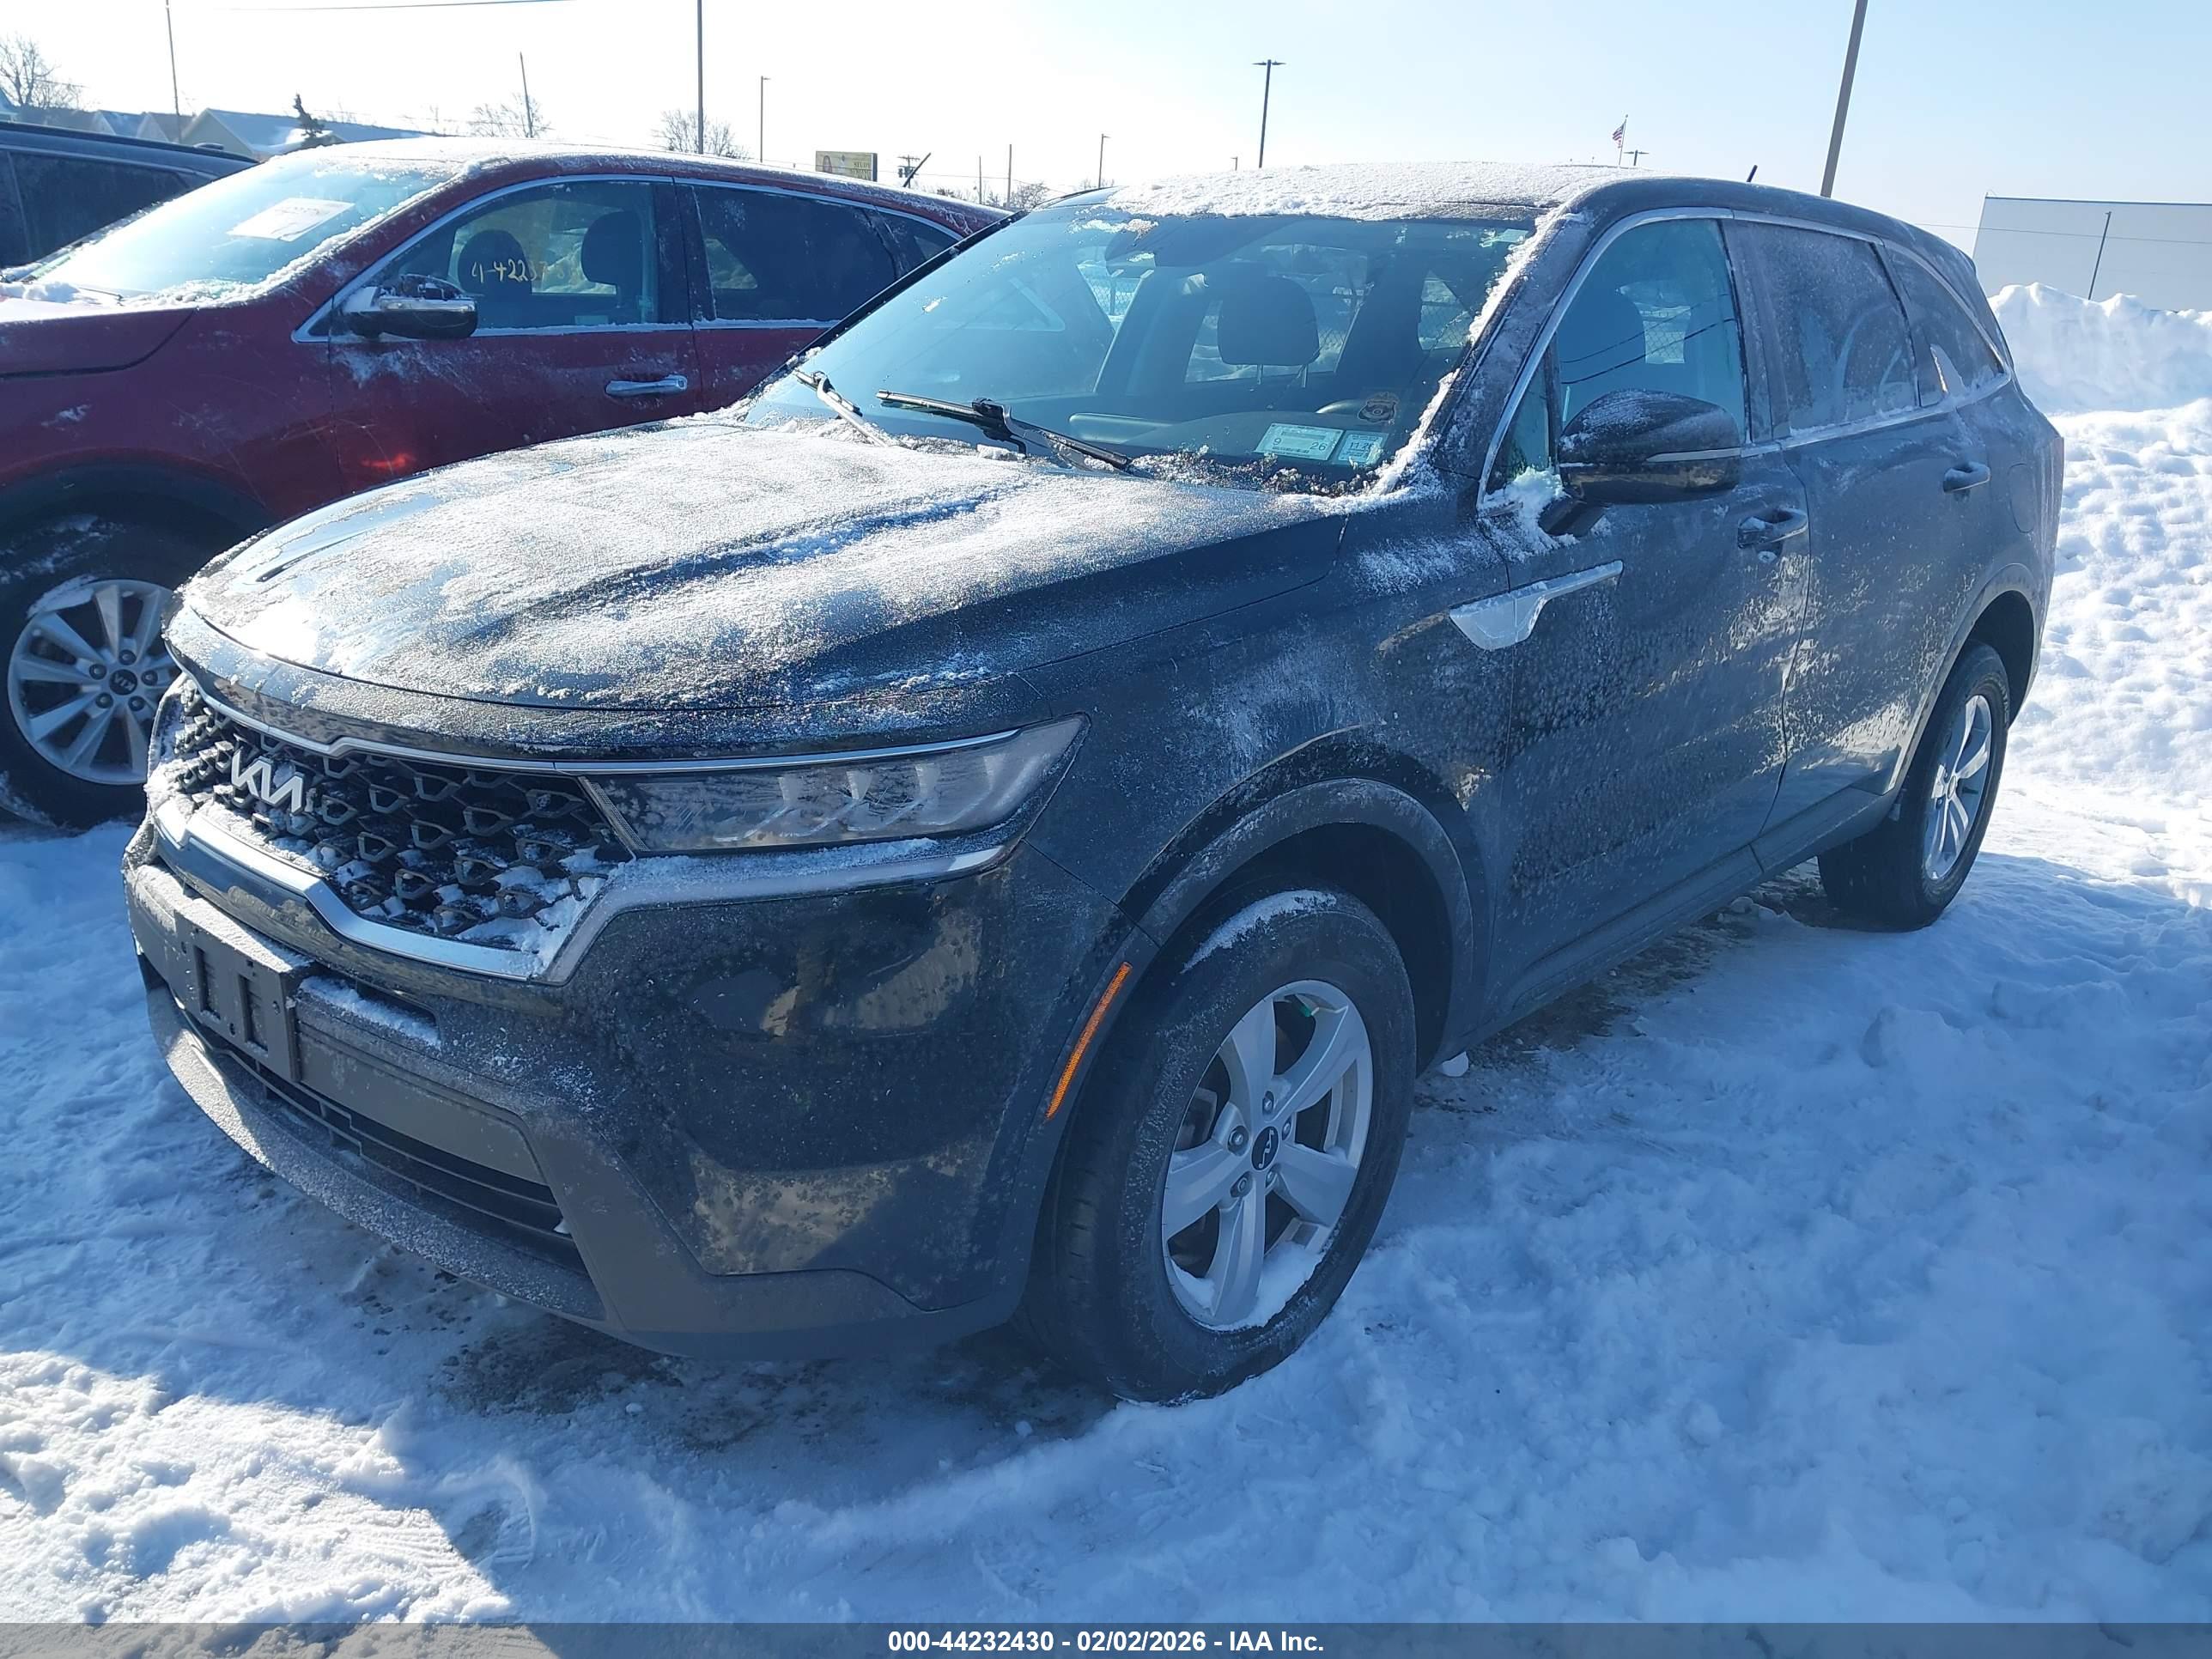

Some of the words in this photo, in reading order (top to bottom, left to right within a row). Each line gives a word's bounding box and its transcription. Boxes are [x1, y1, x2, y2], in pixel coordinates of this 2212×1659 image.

[1273, 437, 1282, 446] 9
[1310, 441, 1328, 451] 26
[231, 748, 303, 813] KIA
